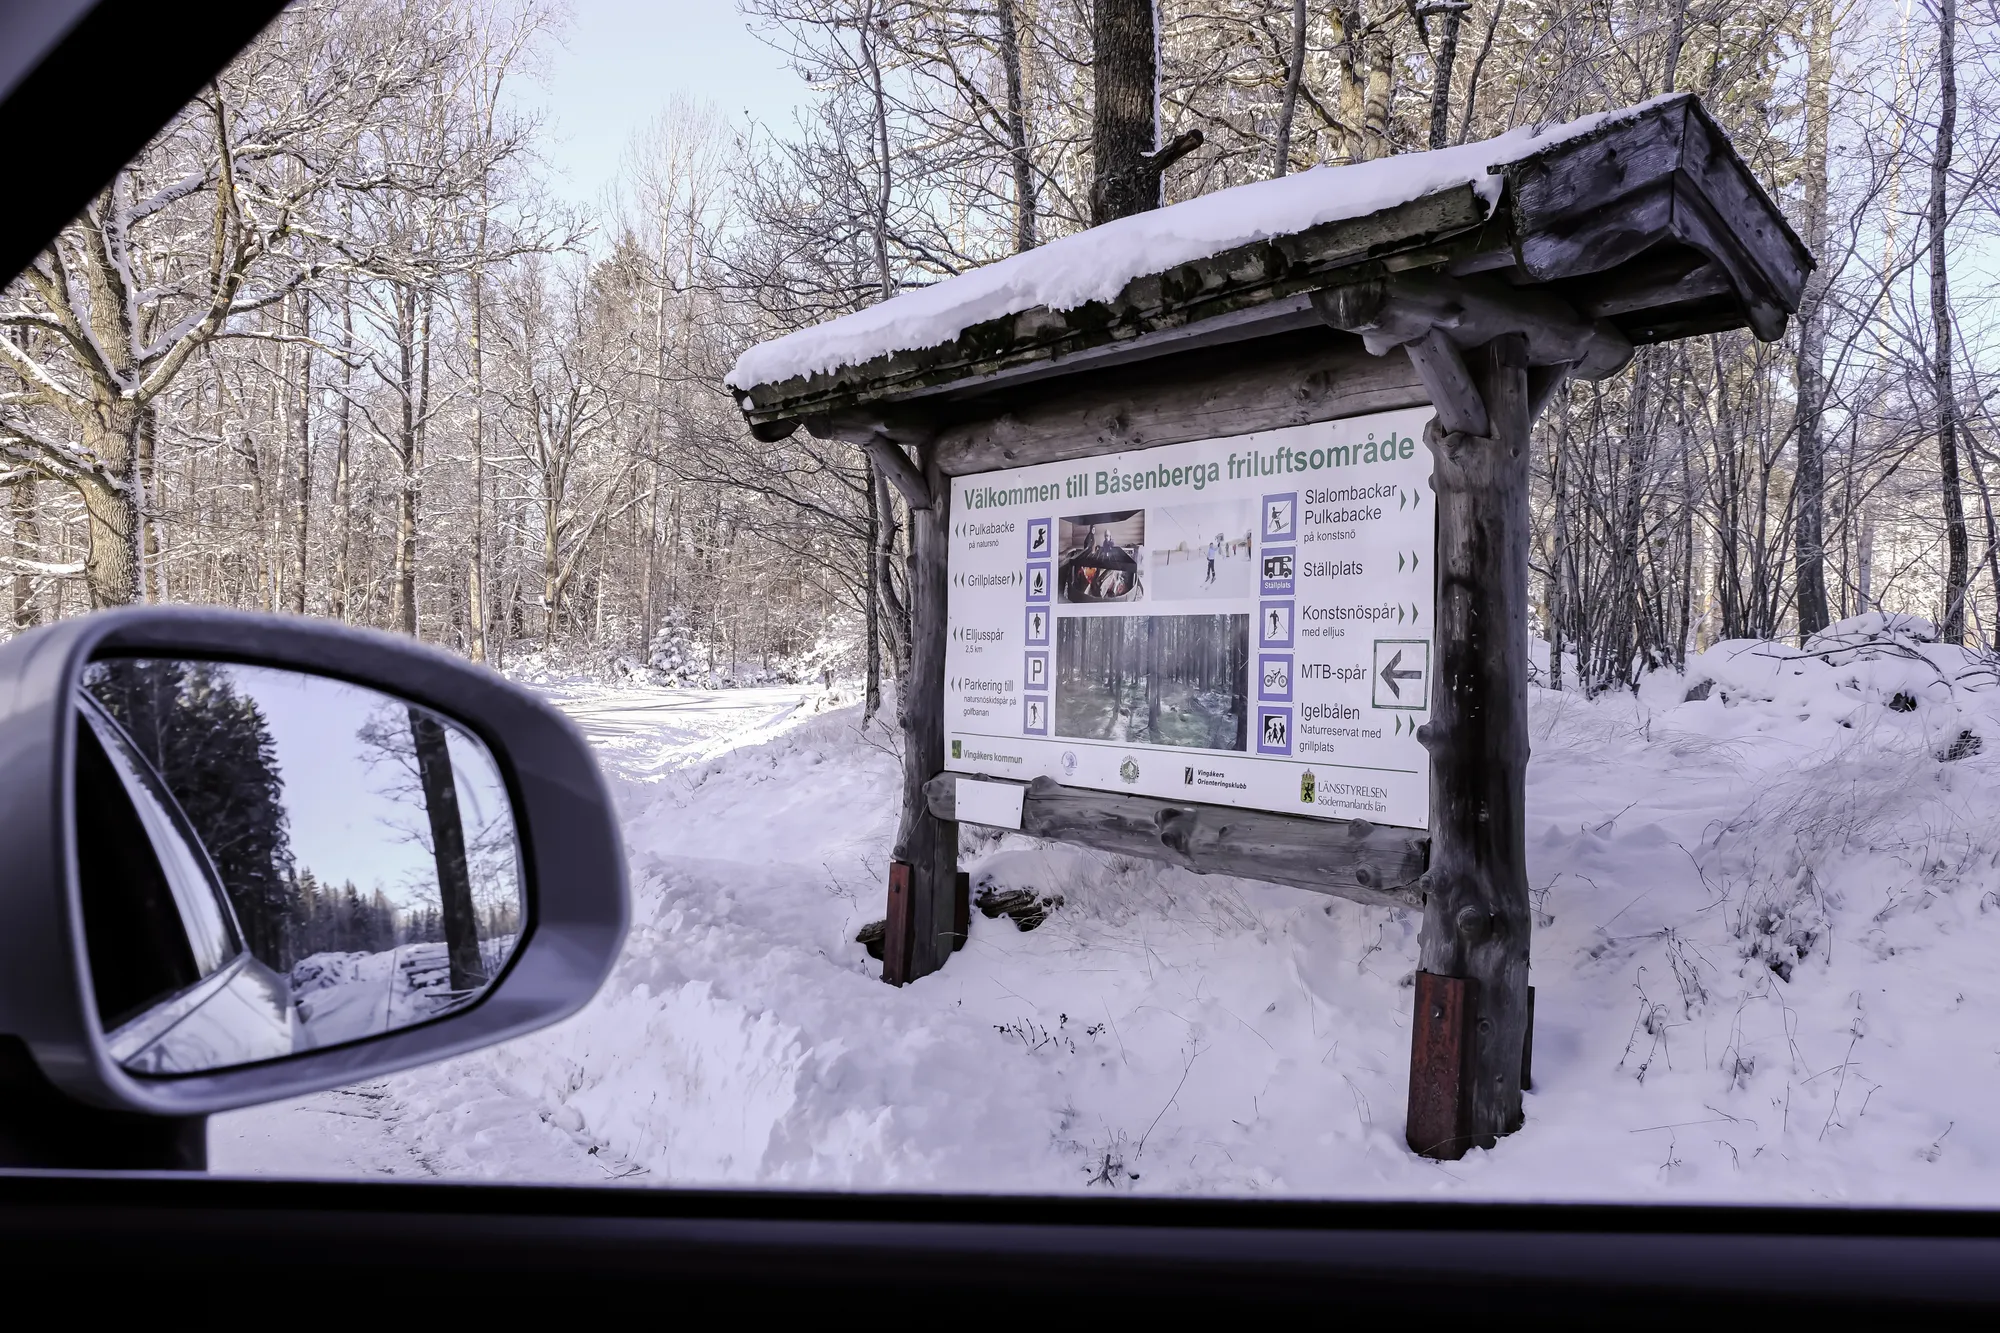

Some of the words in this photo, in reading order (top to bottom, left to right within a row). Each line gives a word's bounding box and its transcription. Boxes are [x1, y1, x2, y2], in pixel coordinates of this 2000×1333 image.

[964, 482, 1059, 510] Välkommen
[1066, 474, 1088, 498] till
[1095, 463, 1220, 491] Båsenberga
[1228, 432, 1414, 479] friluftsområde
[1305, 483, 1397, 504] Slalombackar
[1305, 506, 1381, 525] Pulkabacke
[970, 521, 1014, 536] Pulkabacke
[1304, 533, 1314, 543] på
[1317, 529, 1356, 541] konstsnö
[969, 542, 975, 550] på
[1304, 561, 1363, 579] Ställplats
[968, 574, 1010, 588] Grillplatser
[1264, 582, 1291, 590] Ställplats
[1303, 603, 1395, 625] Konstsnöspår
[966, 629, 1004, 642] Elljusspår
[1302, 627, 1320, 637] med
[1323, 627, 1344, 638] elljus
[1033, 660, 1042, 681] P
[1302, 664, 1367, 684] MTB-spår
[964, 678, 1002, 693] Parkering
[1005, 680, 1013, 692] till
[1010, 698, 1016, 706] på
[964, 708, 989, 717] golfbanan
[1301, 703, 1360, 721] Igelbålen
[1301, 725, 1359, 738] Naturreservat
[1362, 728, 1381, 738] med
[1300, 742, 1334, 753] grillplats
[964, 749, 993, 761] Vingåkers
[994, 753, 1022, 764] kommun
[1198, 769, 1225, 778] Vingåkers
[1198, 778, 1246, 789] Orienteringsklubb
[1318, 780, 1387, 798] LÄNSSTYRELSEN
[1318, 796, 1373, 811] Södermanlands
[1375, 802, 1386, 812] län
